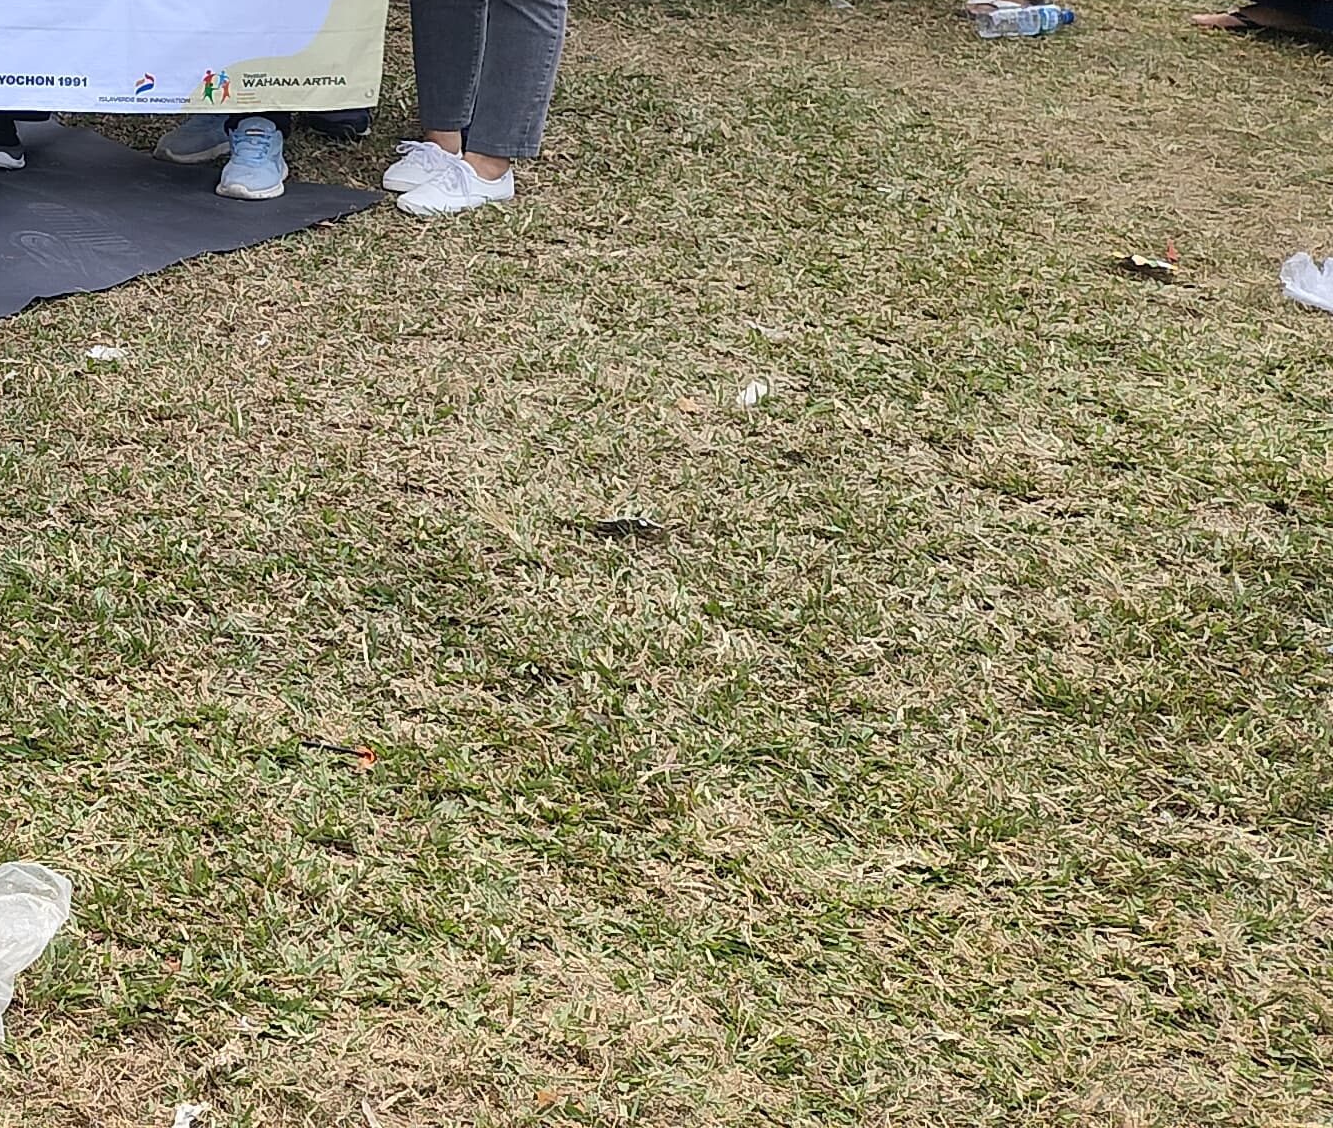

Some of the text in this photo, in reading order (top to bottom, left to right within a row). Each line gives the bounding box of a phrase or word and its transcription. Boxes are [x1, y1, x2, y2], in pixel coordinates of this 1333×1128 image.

[57, 76, 88, 87] 1991
[242, 76, 347, 87] WAHANA ARTHA
